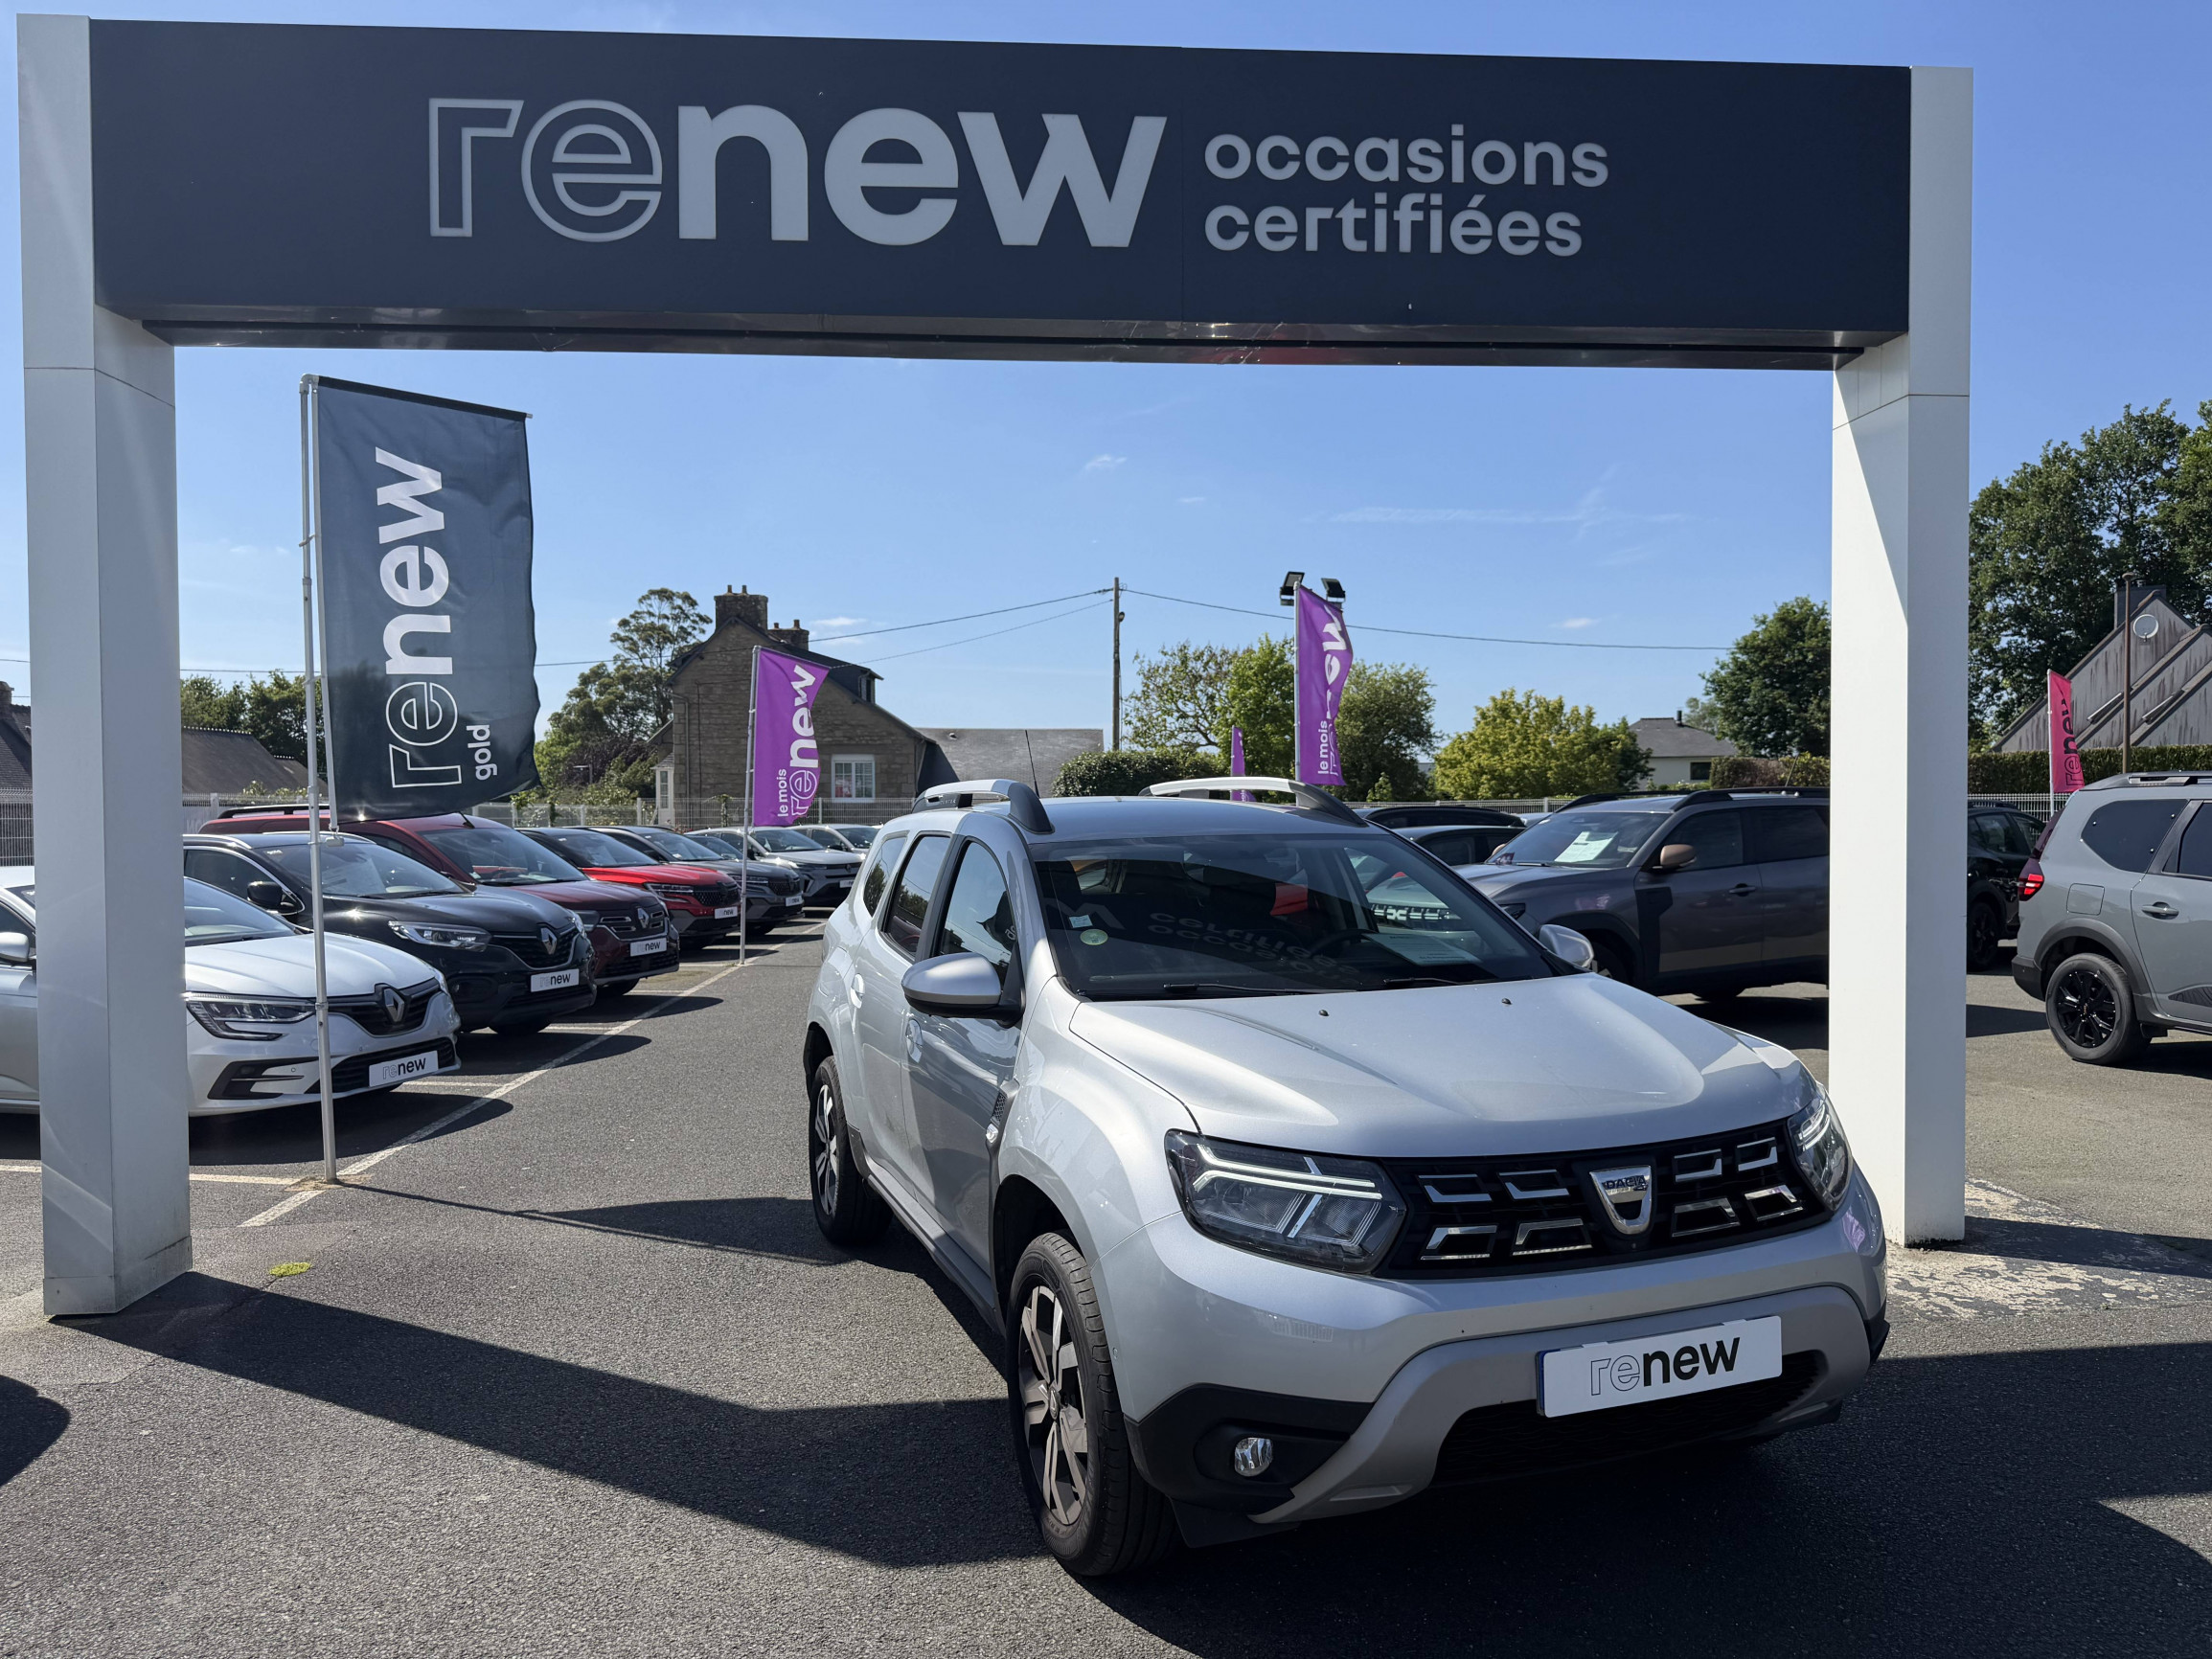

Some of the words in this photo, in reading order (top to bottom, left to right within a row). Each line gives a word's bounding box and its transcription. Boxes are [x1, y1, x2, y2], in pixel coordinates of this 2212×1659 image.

[429, 98, 1168, 247] renew
[1204, 124, 1608, 188] occasions
[1204, 193, 1582, 257] certifiées
[375, 446, 462, 788] renew
[467, 724, 498, 782] gold
[789, 665, 819, 816] renew
[1318, 720, 1329, 758] mois
[2060, 687, 2085, 786] rene
[777, 768, 788, 803] mois
[1318, 761, 1329, 774] le
[778, 804, 788, 817] le
[383, 1057, 426, 1080] renew
[1605, 1174, 1647, 1190] DACIA
[1590, 1336, 1741, 1397] renew
